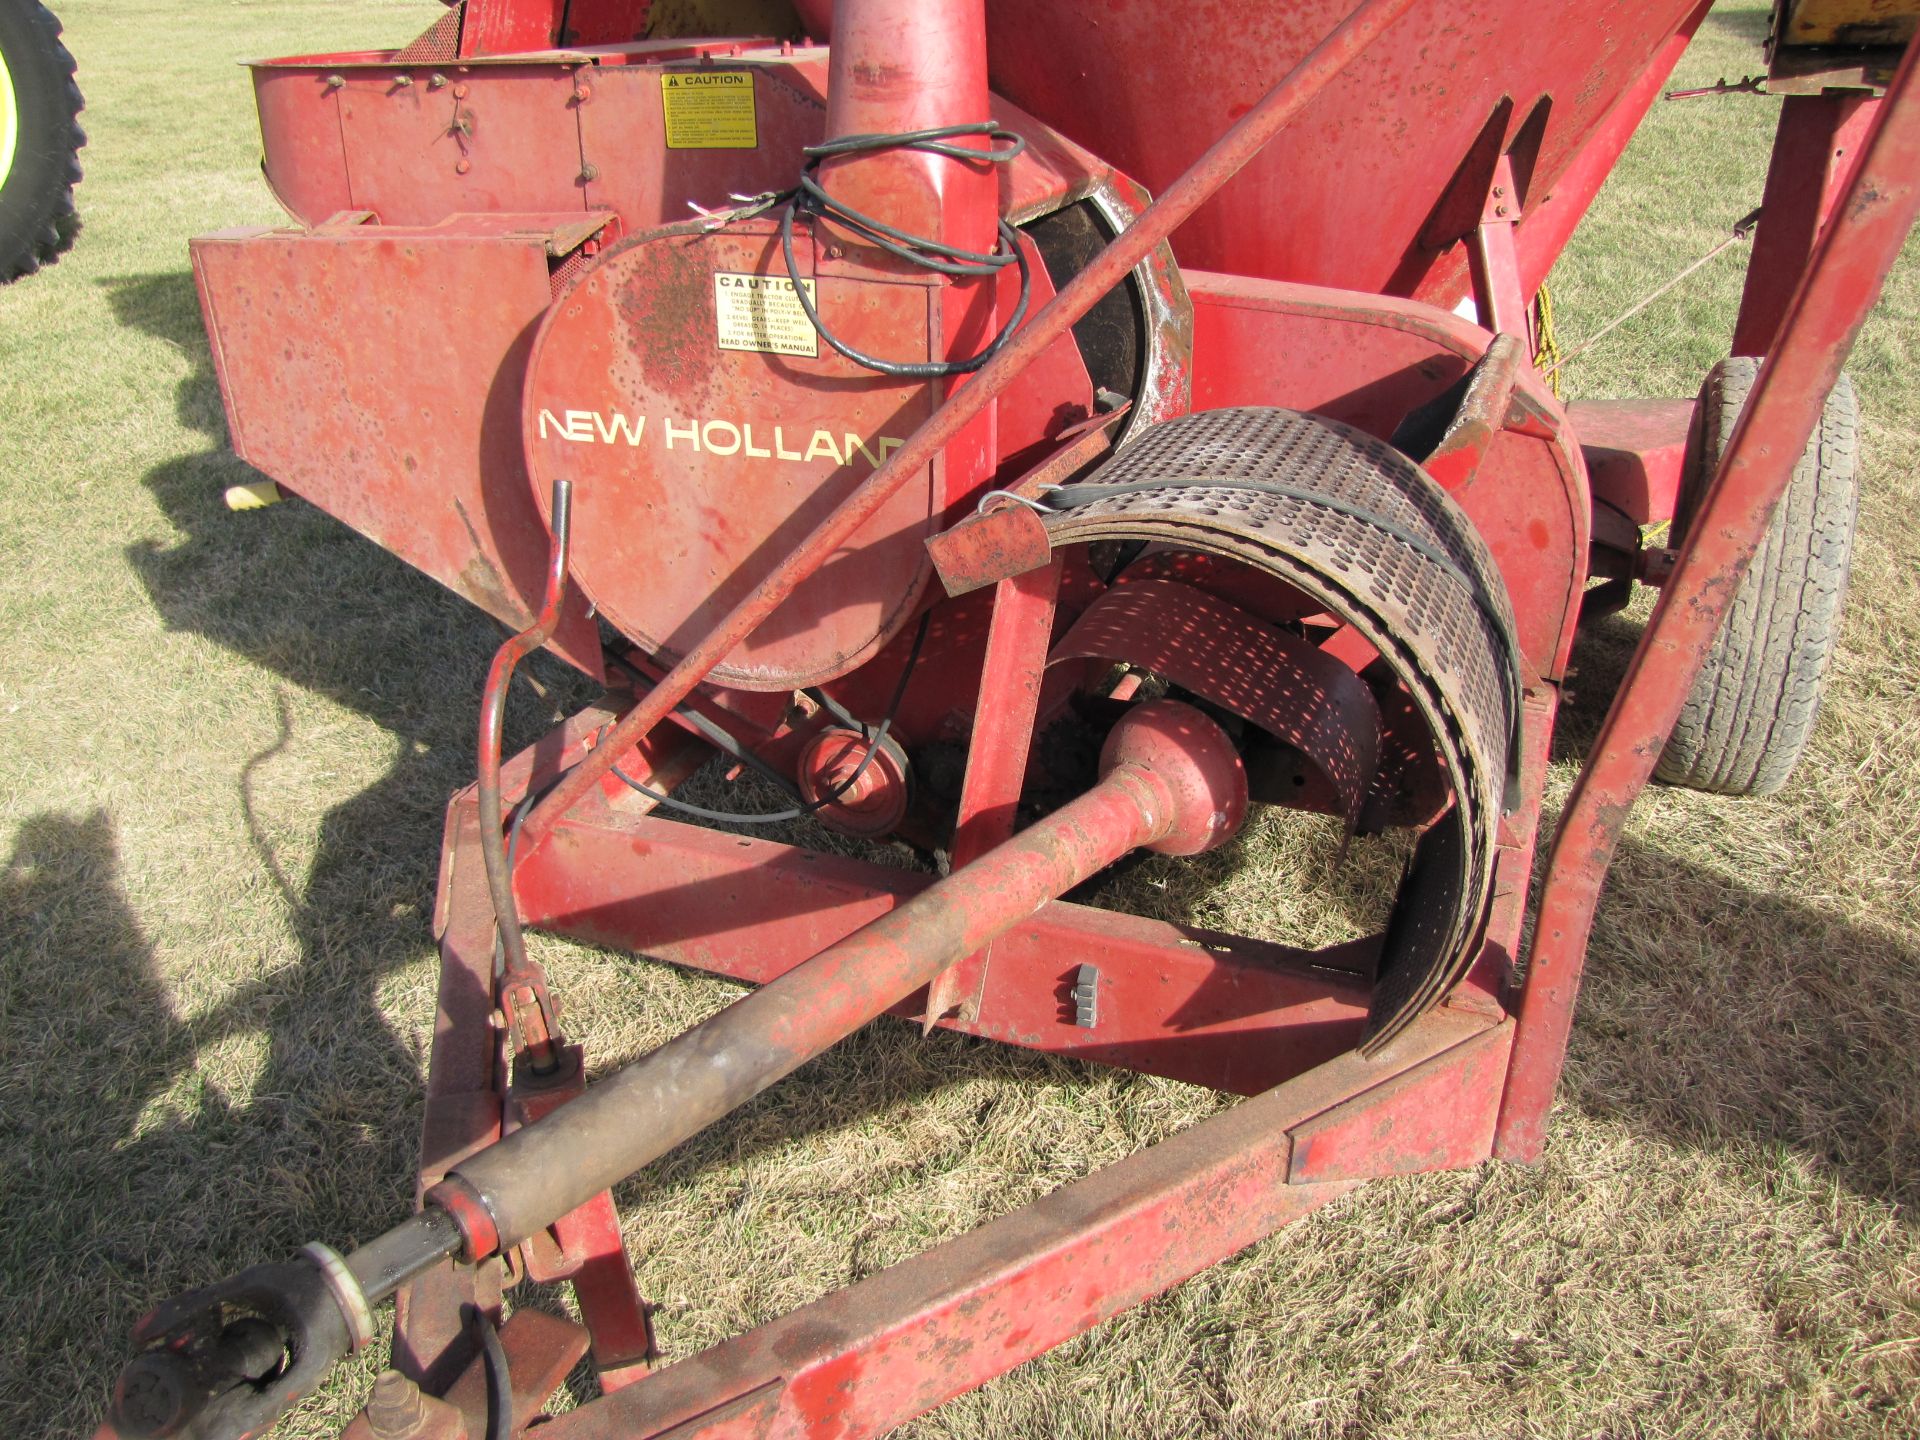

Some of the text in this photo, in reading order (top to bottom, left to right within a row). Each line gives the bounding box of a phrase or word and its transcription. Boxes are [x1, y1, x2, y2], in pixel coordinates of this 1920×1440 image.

[685, 75, 744, 85] CAUTION
[720, 277, 810, 293] CAUTION
[731, 299, 765, 307] GRADUALLY
[769, 301, 796, 309] BECAUSE
[746, 331, 767, 339] BETTER
[721, 338, 815, 353] READ OWNER'S MANUAL
[539, 408, 646, 447] NEW
